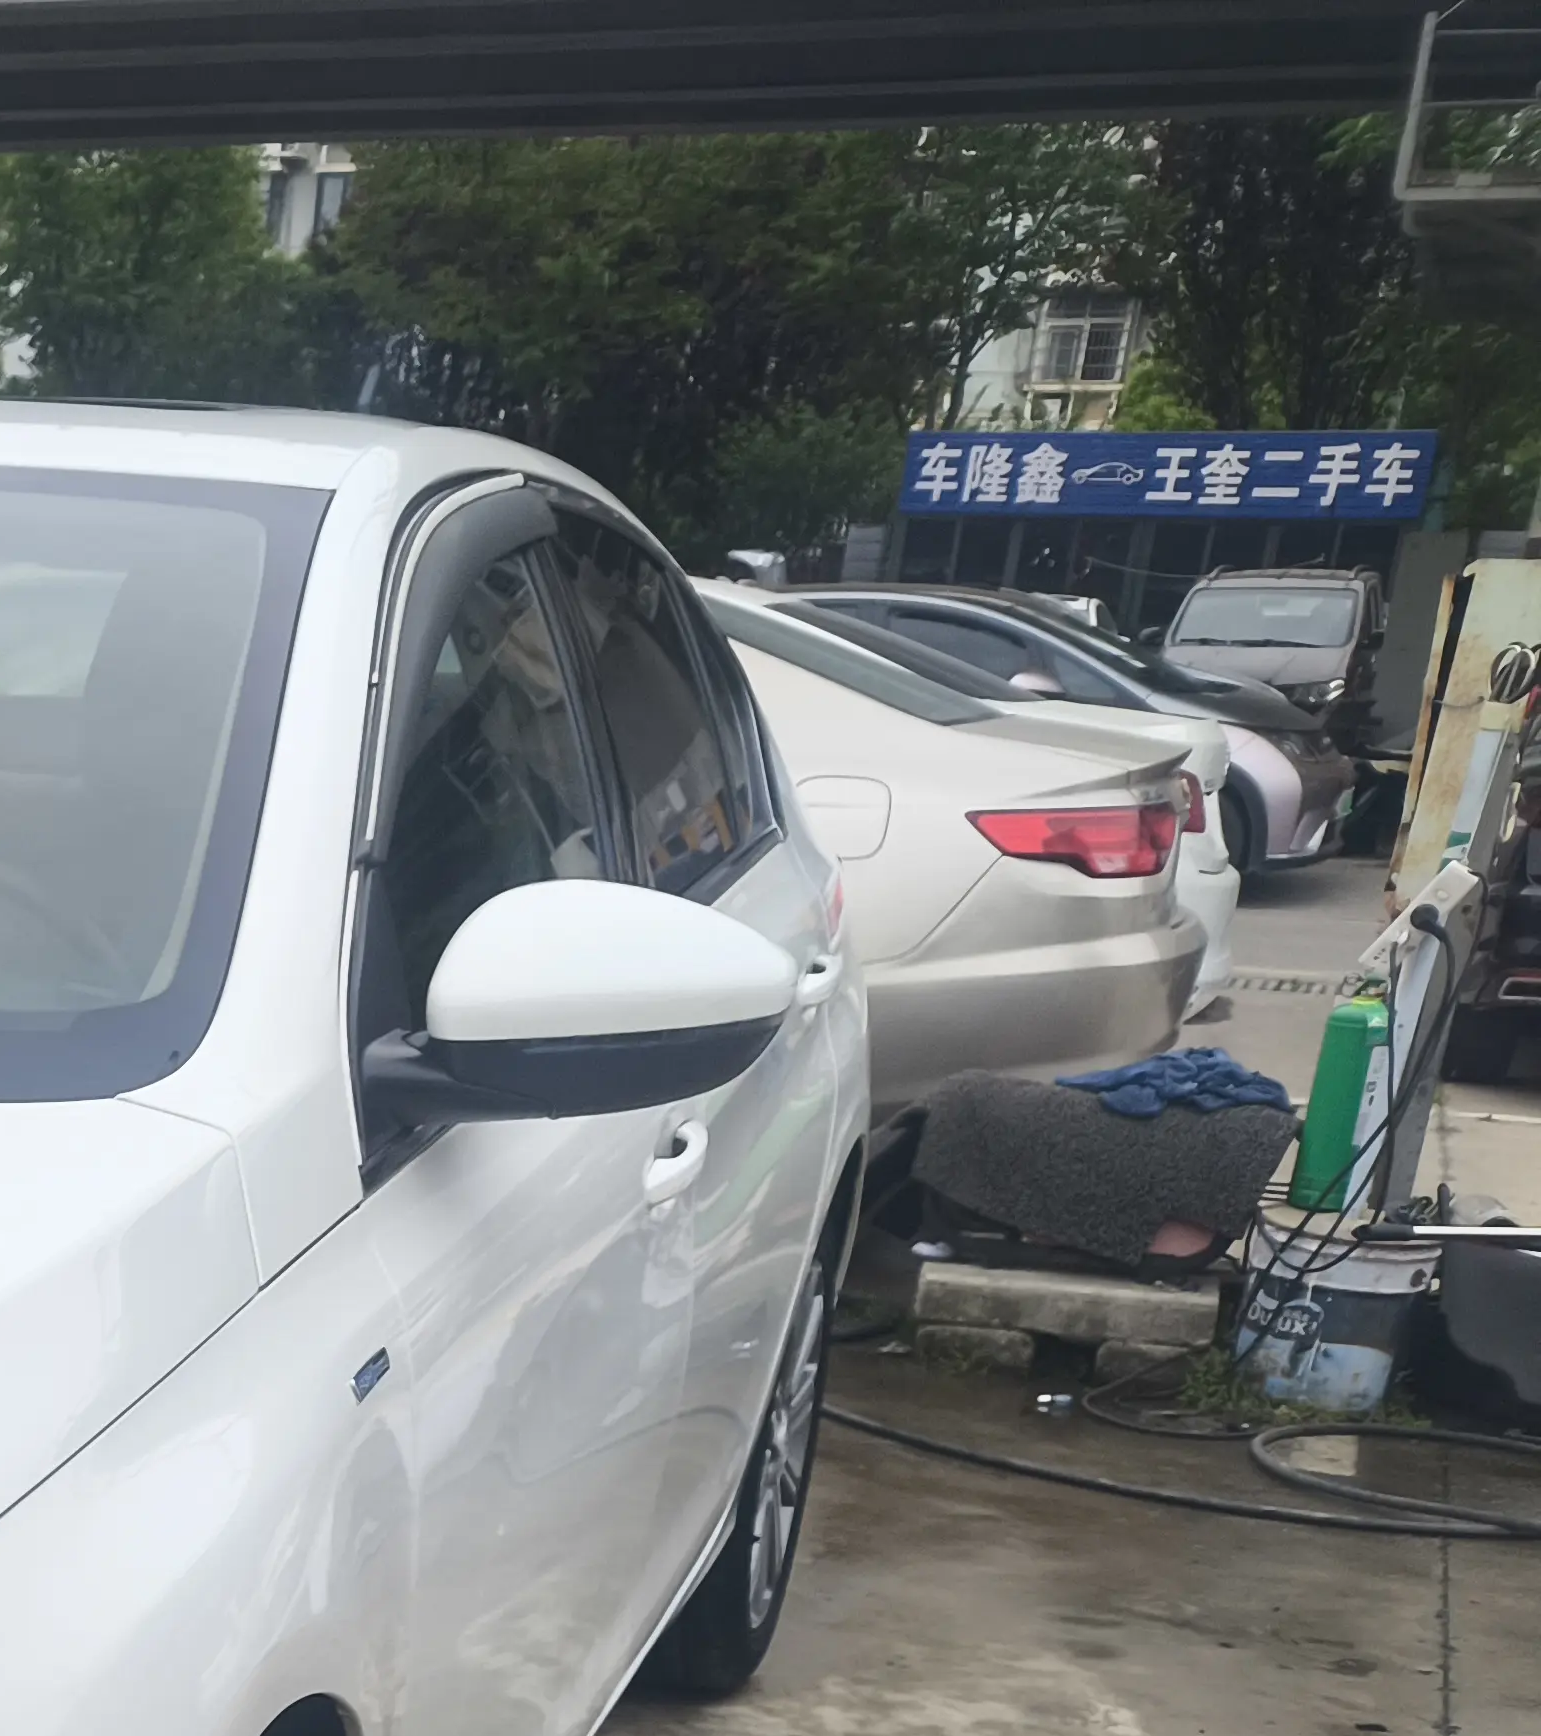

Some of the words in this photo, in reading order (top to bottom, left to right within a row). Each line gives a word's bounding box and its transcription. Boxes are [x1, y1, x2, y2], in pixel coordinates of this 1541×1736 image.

[914, 441, 1069, 504] 车隆鑫
[1144, 442, 1421, 507] 王奎二手车
